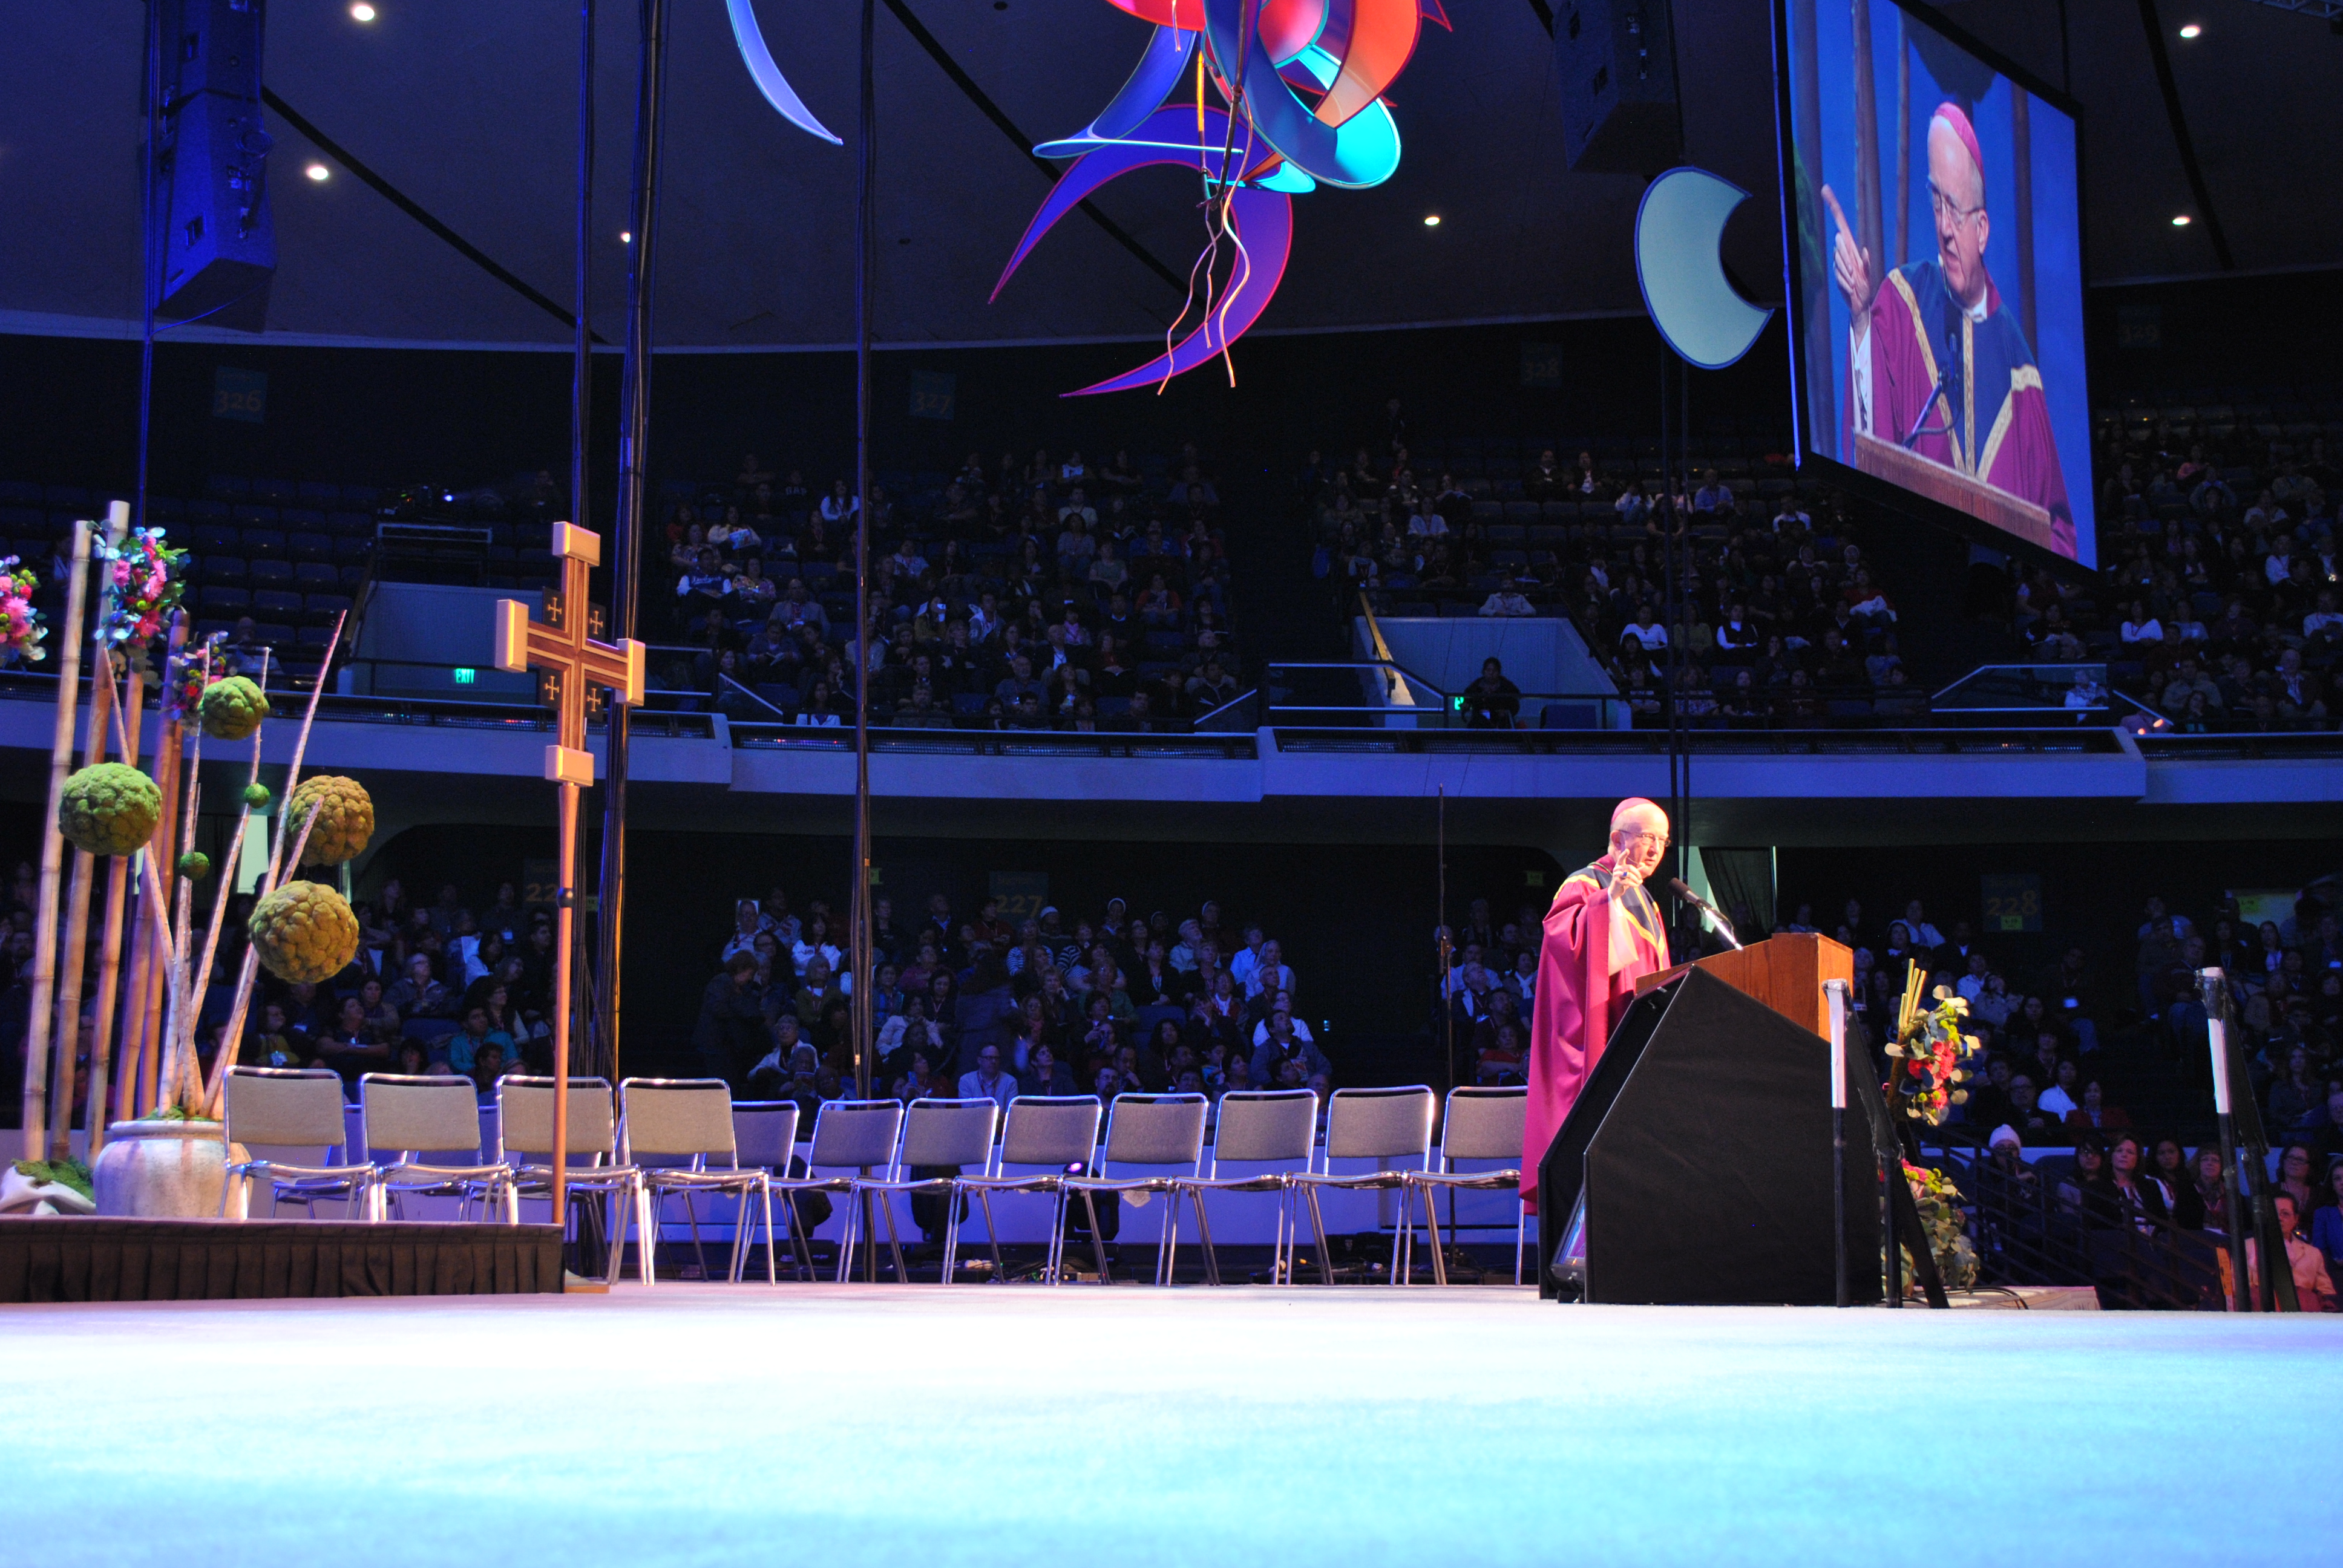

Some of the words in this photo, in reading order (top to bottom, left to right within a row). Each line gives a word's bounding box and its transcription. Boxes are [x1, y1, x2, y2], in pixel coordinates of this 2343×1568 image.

[1524, 356, 1559, 382] 328
[217, 390, 262, 413] 326
[914, 391, 952, 414] 327
[455, 668, 475, 684] EXIT
[525, 882, 558, 903] 22
[1987, 890, 2038, 915] 228
[995, 895, 1043, 918] 227
